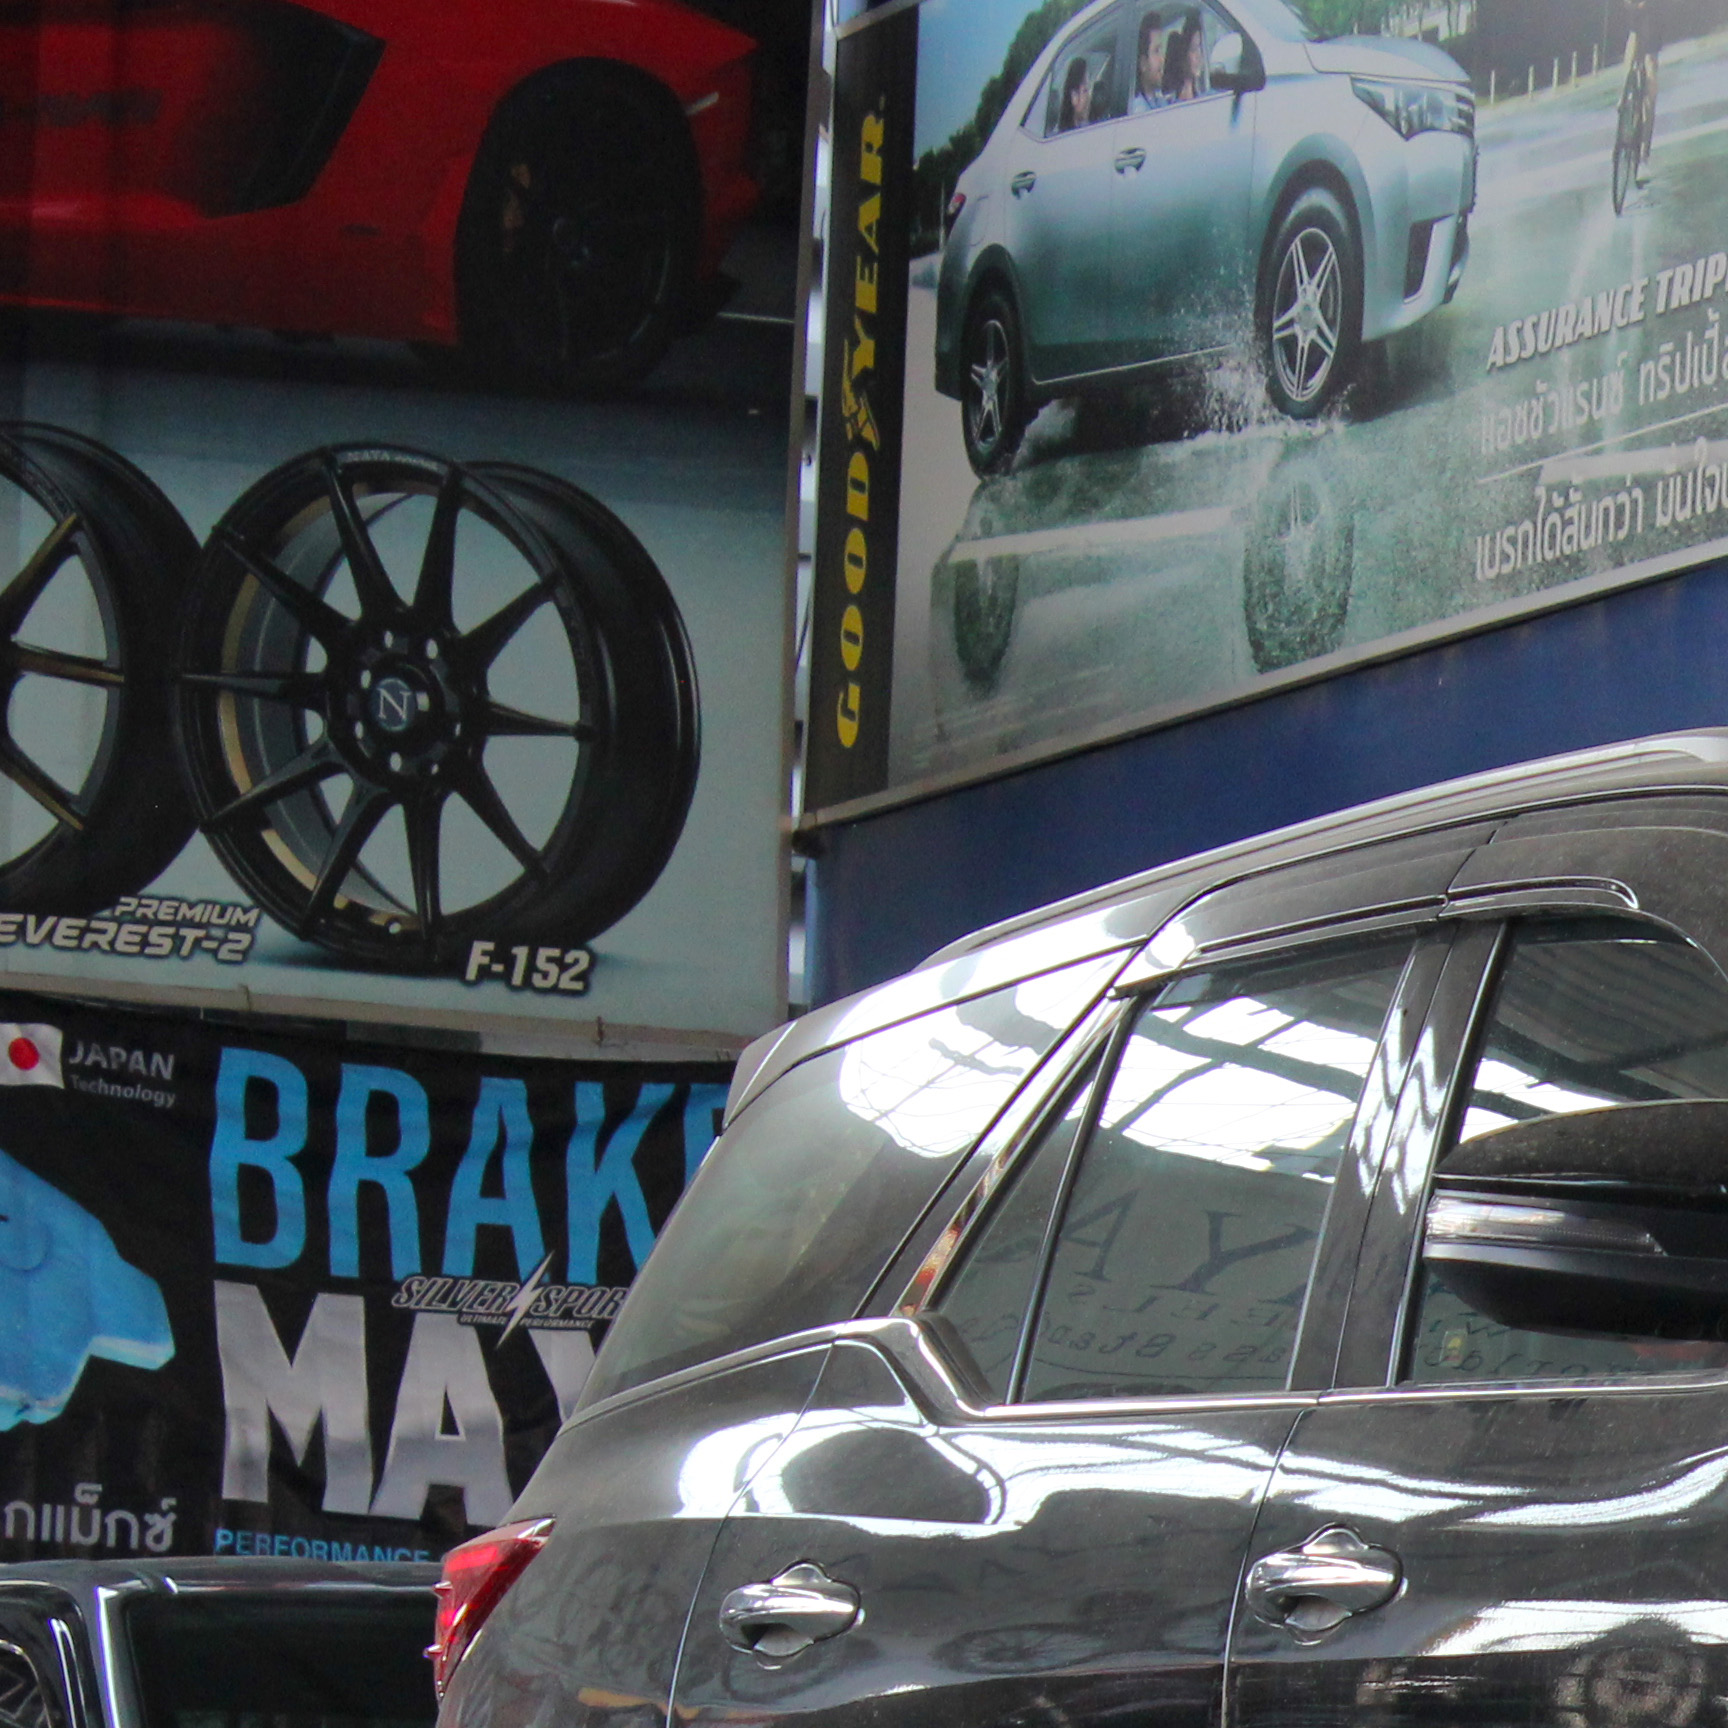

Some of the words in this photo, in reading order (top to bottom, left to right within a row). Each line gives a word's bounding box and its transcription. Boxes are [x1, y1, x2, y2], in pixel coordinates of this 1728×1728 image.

[1486, 276, 1650, 372] ASSURANCE
[837, 113, 884, 748] GOODYEAR
[114, 896, 261, 927] PREMIUM
[465, 940, 590, 991] F-152
[69, 1041, 175, 1080] JAPAN
[70, 1074, 176, 1108] Technology
[391, 1276, 520, 1312] SILVER
